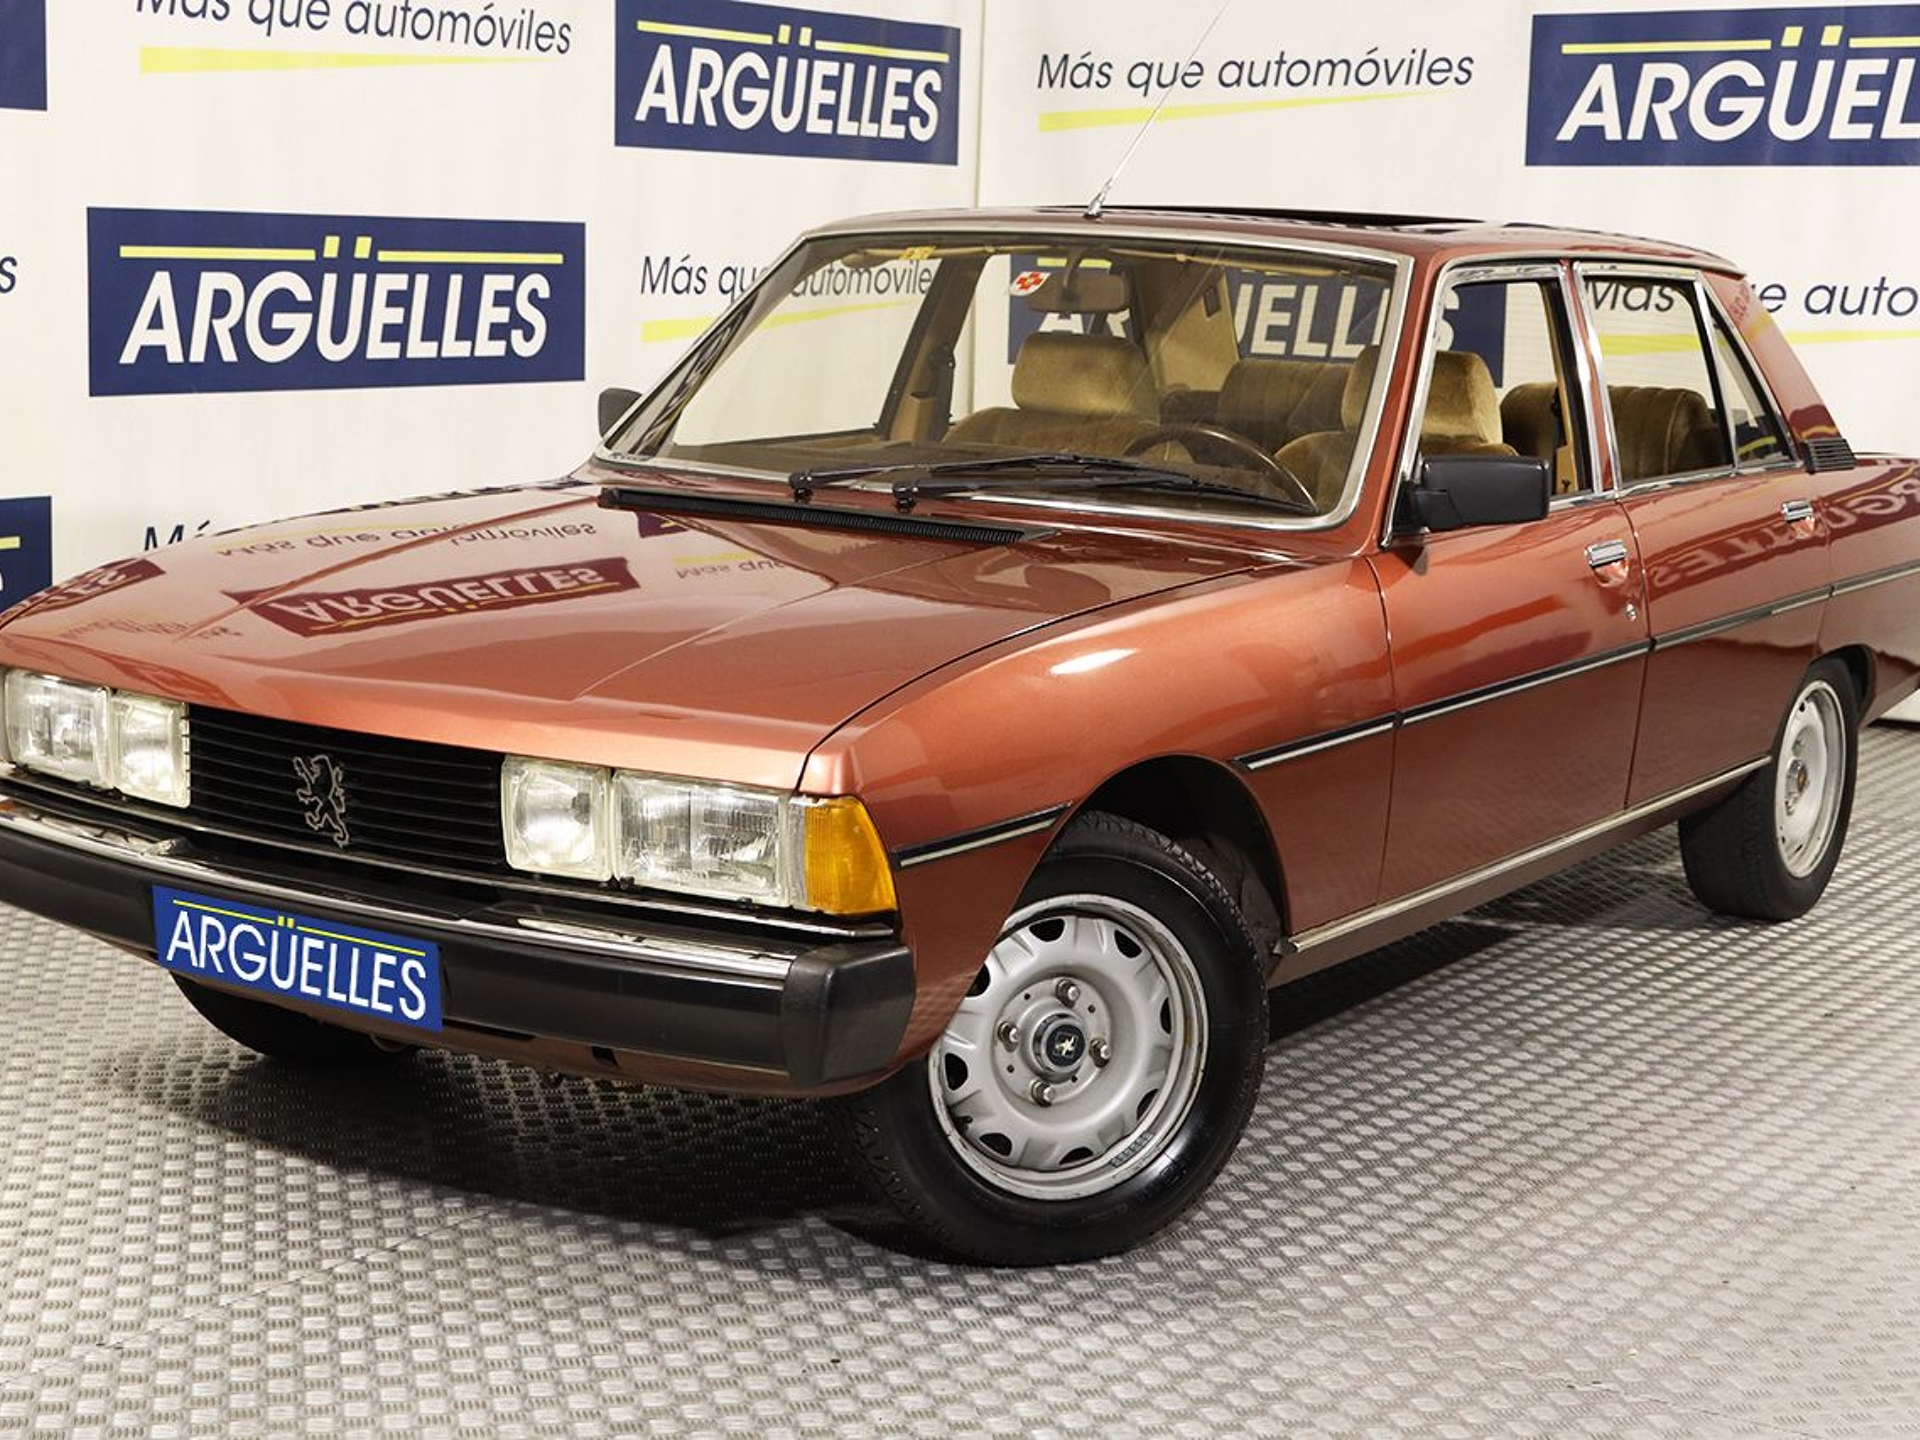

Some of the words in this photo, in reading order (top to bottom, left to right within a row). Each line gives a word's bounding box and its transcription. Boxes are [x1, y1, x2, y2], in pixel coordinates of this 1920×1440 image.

[248, 0, 330, 37] que
[345, 0, 572, 55] automóviles
[635, 24, 943, 142] ARGÜELLES
[1037, 51, 1113, 89] Más
[1128, 60, 1204, 99] que
[1218, 47, 1474, 89] automóviles
[119, 235, 551, 364] ARGÜELLES
[640, 254, 708, 295] Más
[166, 910, 427, 1021] ARGÜELLES
